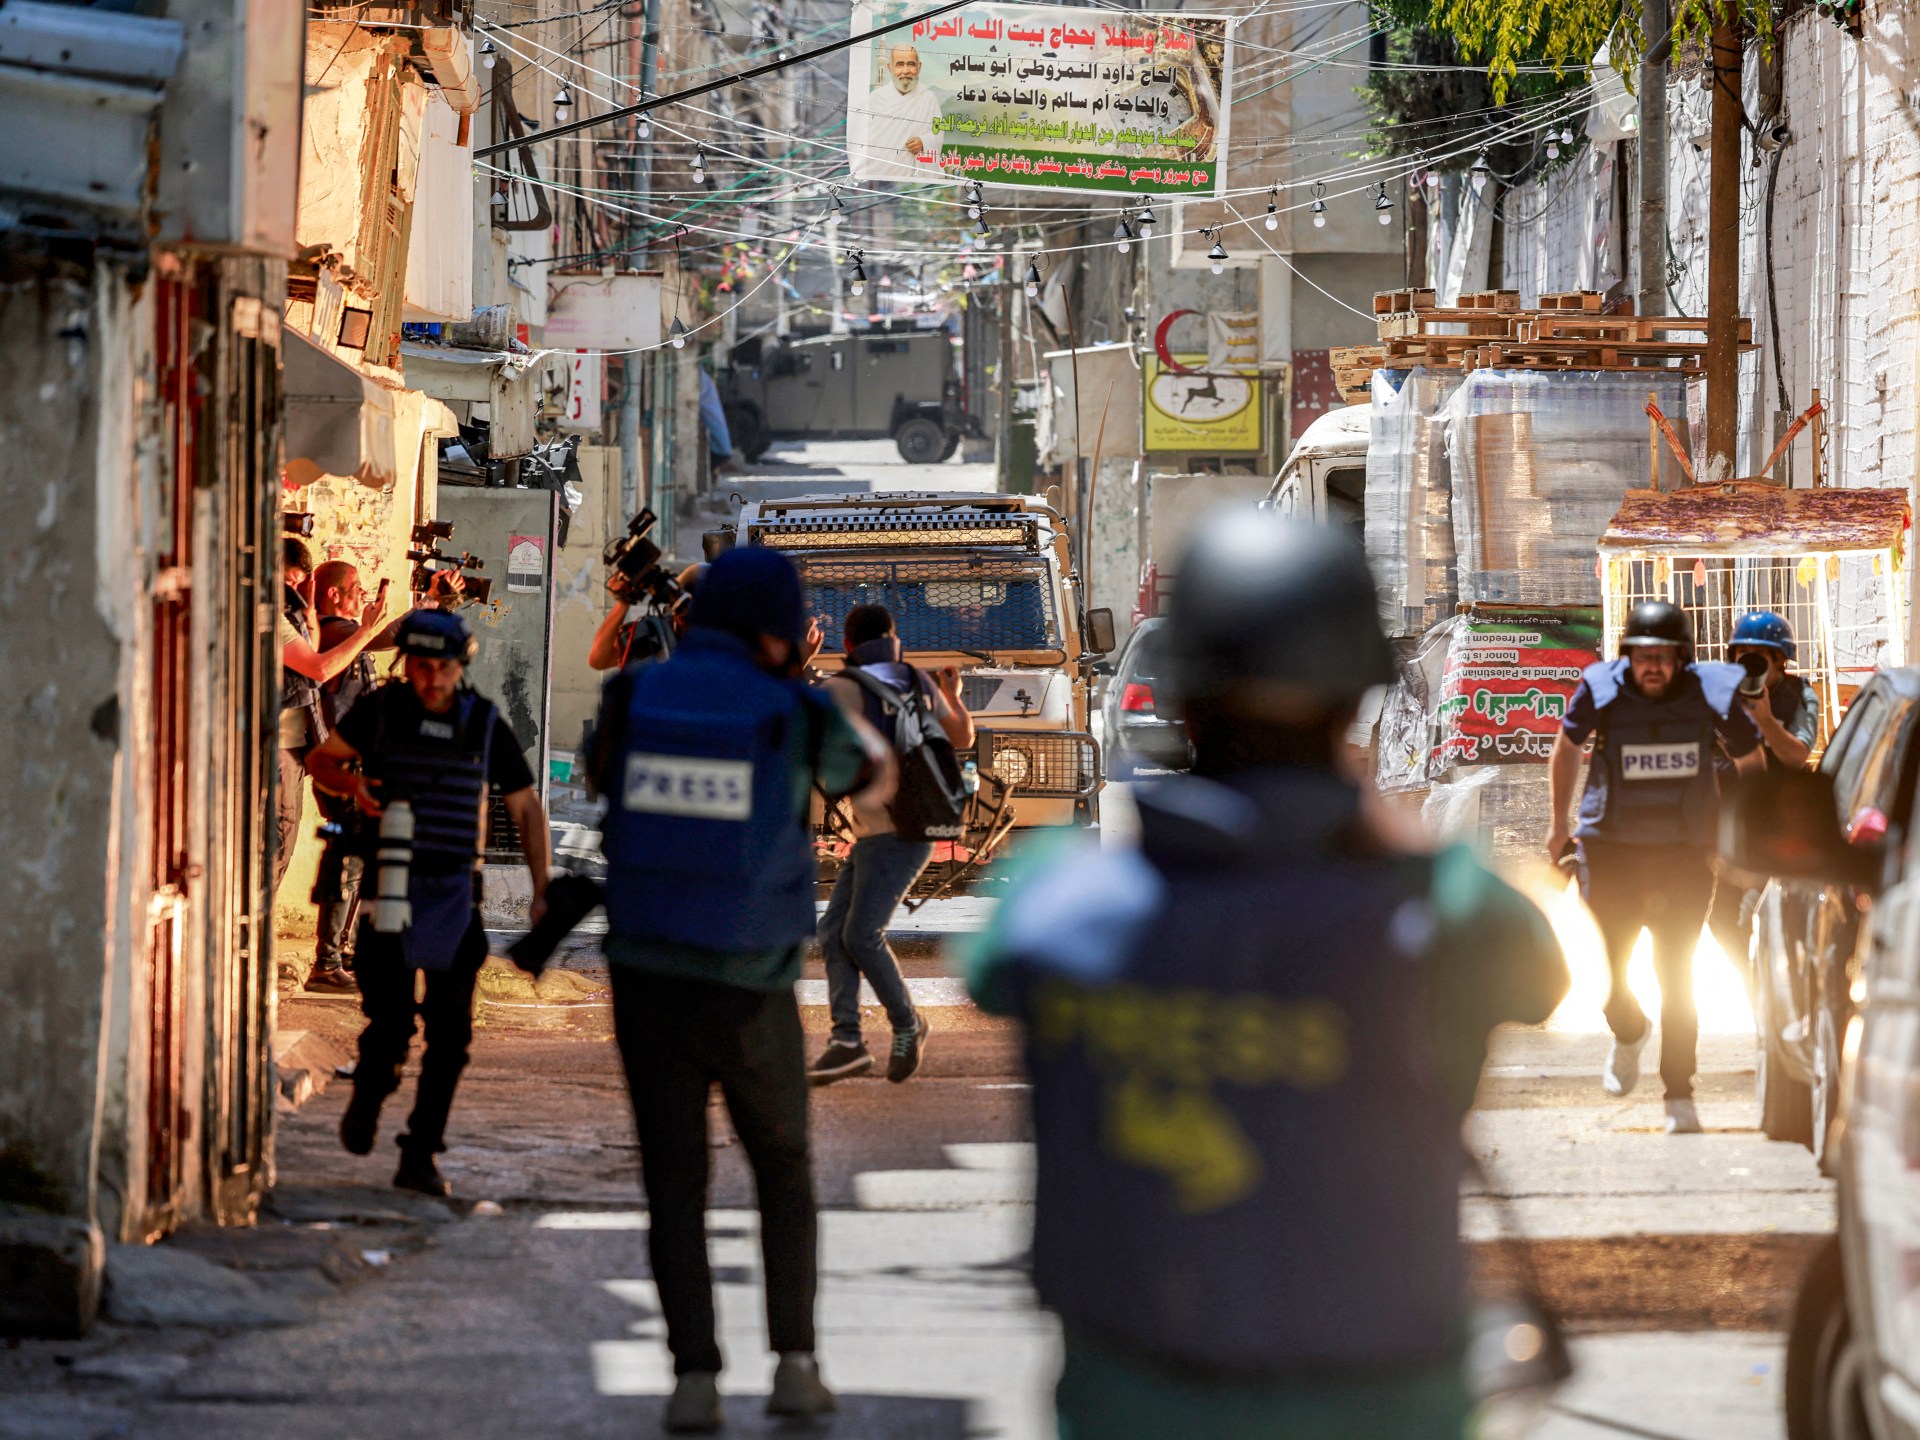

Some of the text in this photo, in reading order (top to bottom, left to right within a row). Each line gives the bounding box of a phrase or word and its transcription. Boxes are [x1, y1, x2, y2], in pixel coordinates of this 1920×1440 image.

[912, 16, 963, 42] الحرام
[967, 18, 1003, 41] الله
[1007, 23, 1045, 47] بيت
[1050, 22, 1096, 50] بحجاج
[1102, 23, 1155, 54] وسهلاً
[949, 53, 1177, 87] الحاج داود النمروطي أبو سالم
[956, 84, 1169, 118] والحاجة أم سالم والحاجة دعاء
[932, 112, 955, 135] الحج
[956, 114, 988, 137] فريضة
[990, 112, 1008, 135] أداء
[1009, 120, 1028, 140] بعد
[1029, 118, 1068, 142] الحجازية
[1069, 121, 1097, 145] الديار
[1099, 128, 1114, 146] من
[1116, 127, 1155, 148] عودتهم
[916, 149, 1209, 186] حج مبرور وسعي مشكور وذنب مغفور وتجارة لن تبور بإذن الله
[1472, 635, 1516, 643] freedom
[1519, 635, 1539, 643] and
[1473, 652, 1482, 660] is
[1484, 652, 1516, 660] honor
[1463, 669, 1519, 678] Palestinian
[1522, 669, 1531, 677] is
[1534, 669, 1557, 677] land
[1559, 669, 1580, 677] Our
[1623, 750, 1698, 772] PRESS
[625, 764, 743, 804] PRESS
